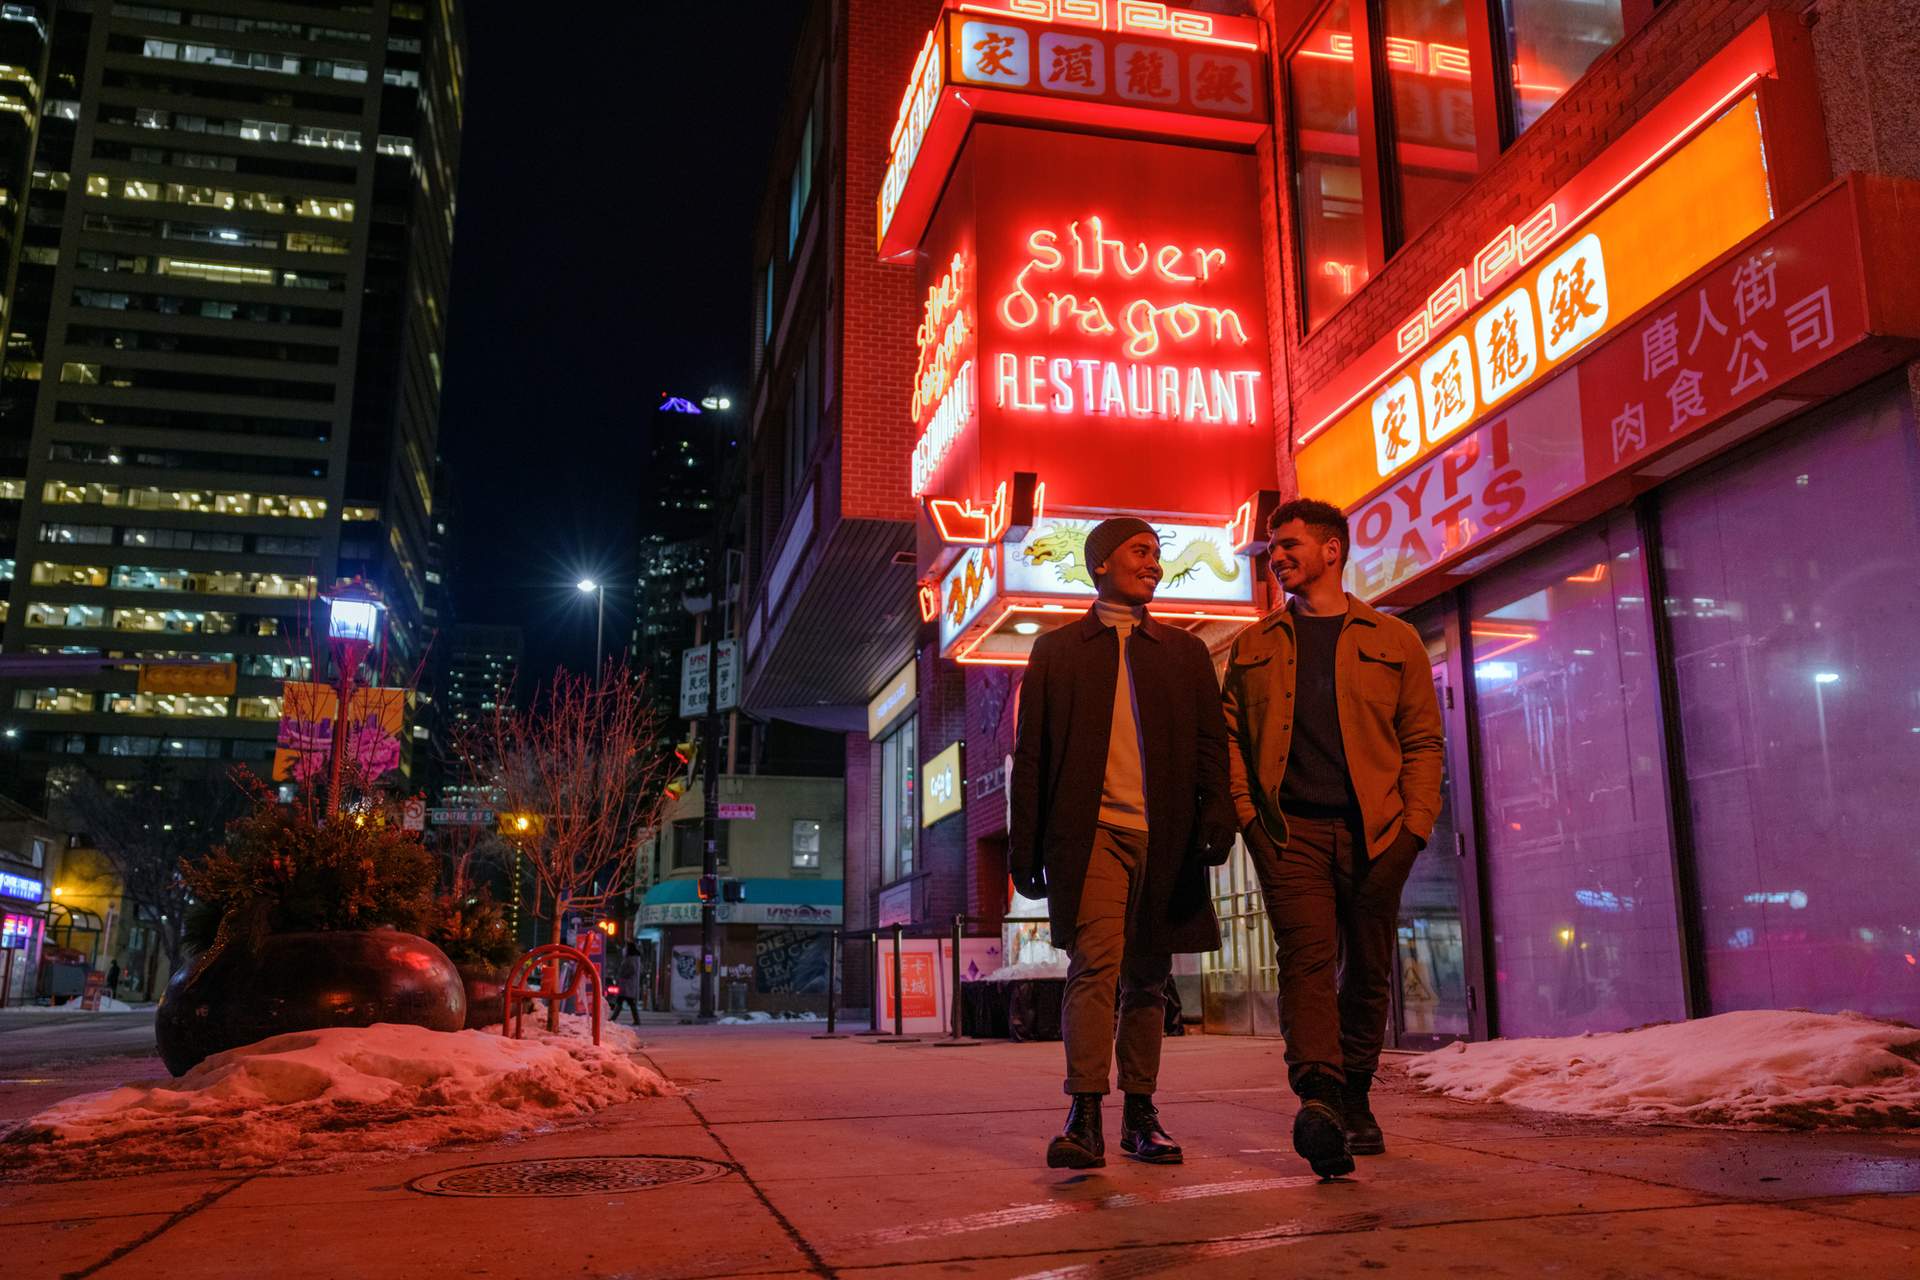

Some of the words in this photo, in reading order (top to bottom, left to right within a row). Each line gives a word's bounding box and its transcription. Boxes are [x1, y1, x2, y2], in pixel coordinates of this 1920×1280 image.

[1611, 285, 1835, 464] 肉食公司
[1643, 248, 1779, 383] 唐人街
[911, 359, 973, 498] RESTAURANT
[997, 352, 1263, 427] RESTAURANT
[433, 812, 468, 821] CENTRE
[471, 812, 483, 821] ST
[484, 812, 491, 821] S
